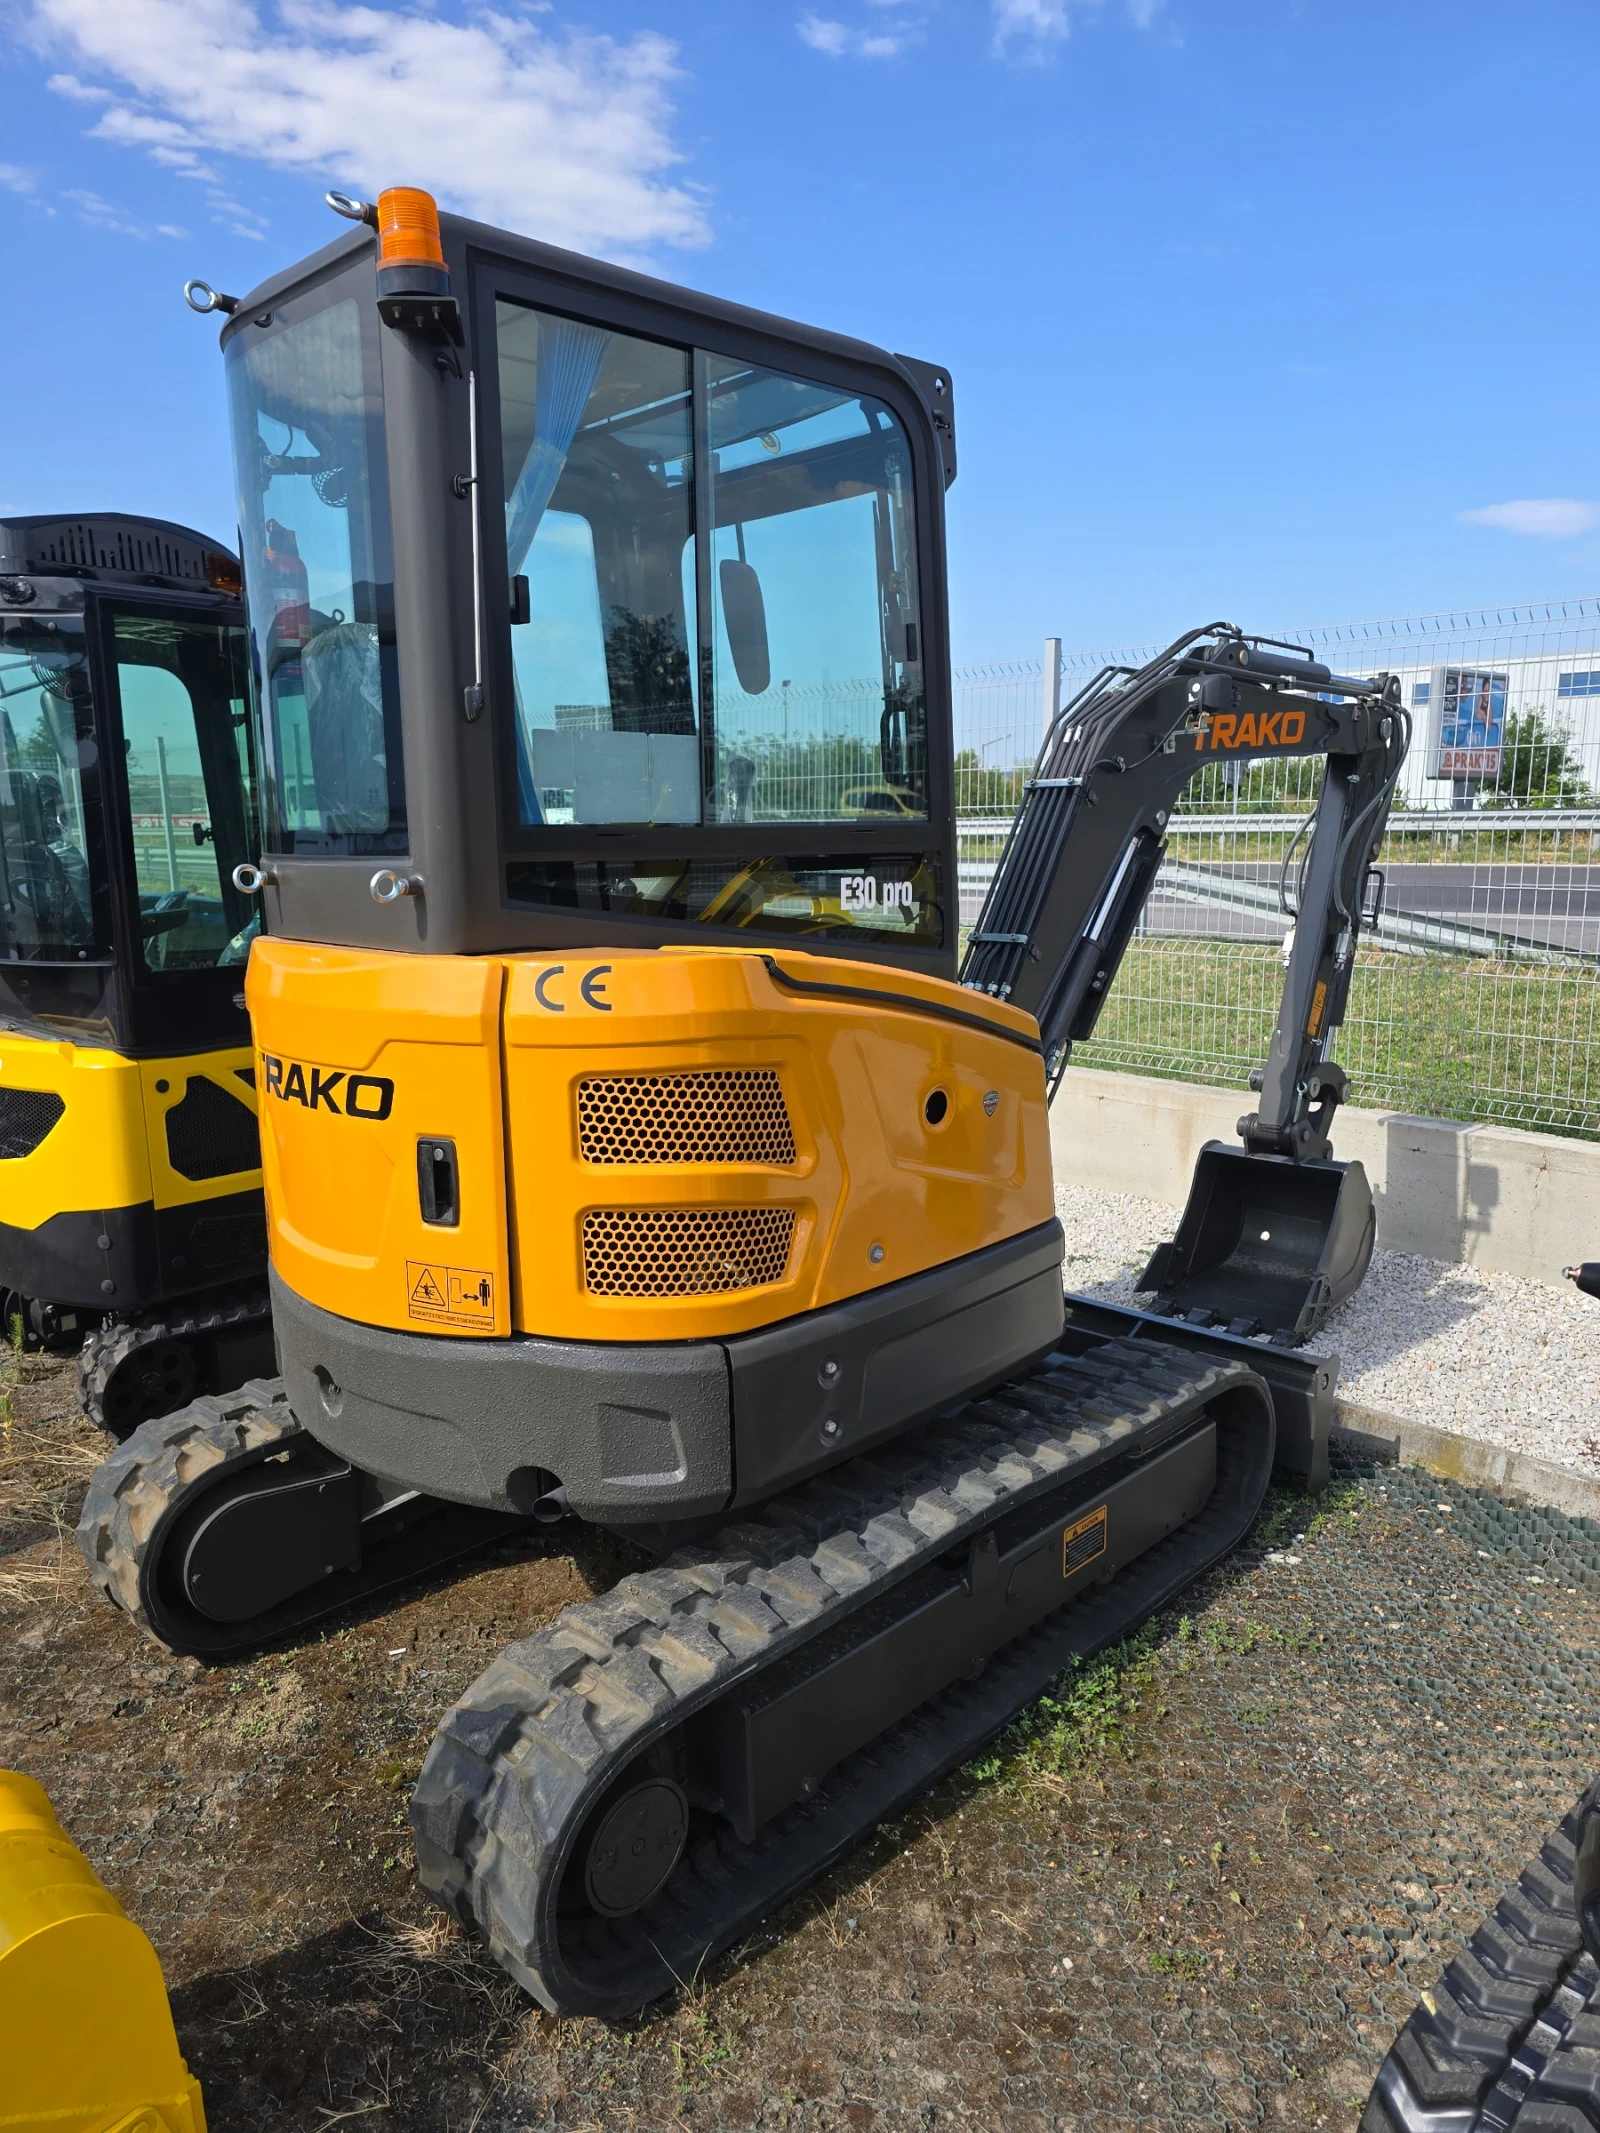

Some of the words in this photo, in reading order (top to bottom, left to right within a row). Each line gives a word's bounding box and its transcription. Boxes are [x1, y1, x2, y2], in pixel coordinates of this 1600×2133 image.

[1194, 711, 1306, 751] TRAKO
[840, 876, 877, 911] E30
[882, 881, 913, 916] pro
[534, 965, 613, 1012] CE
[261, 1051, 395, 1121] RAKO
